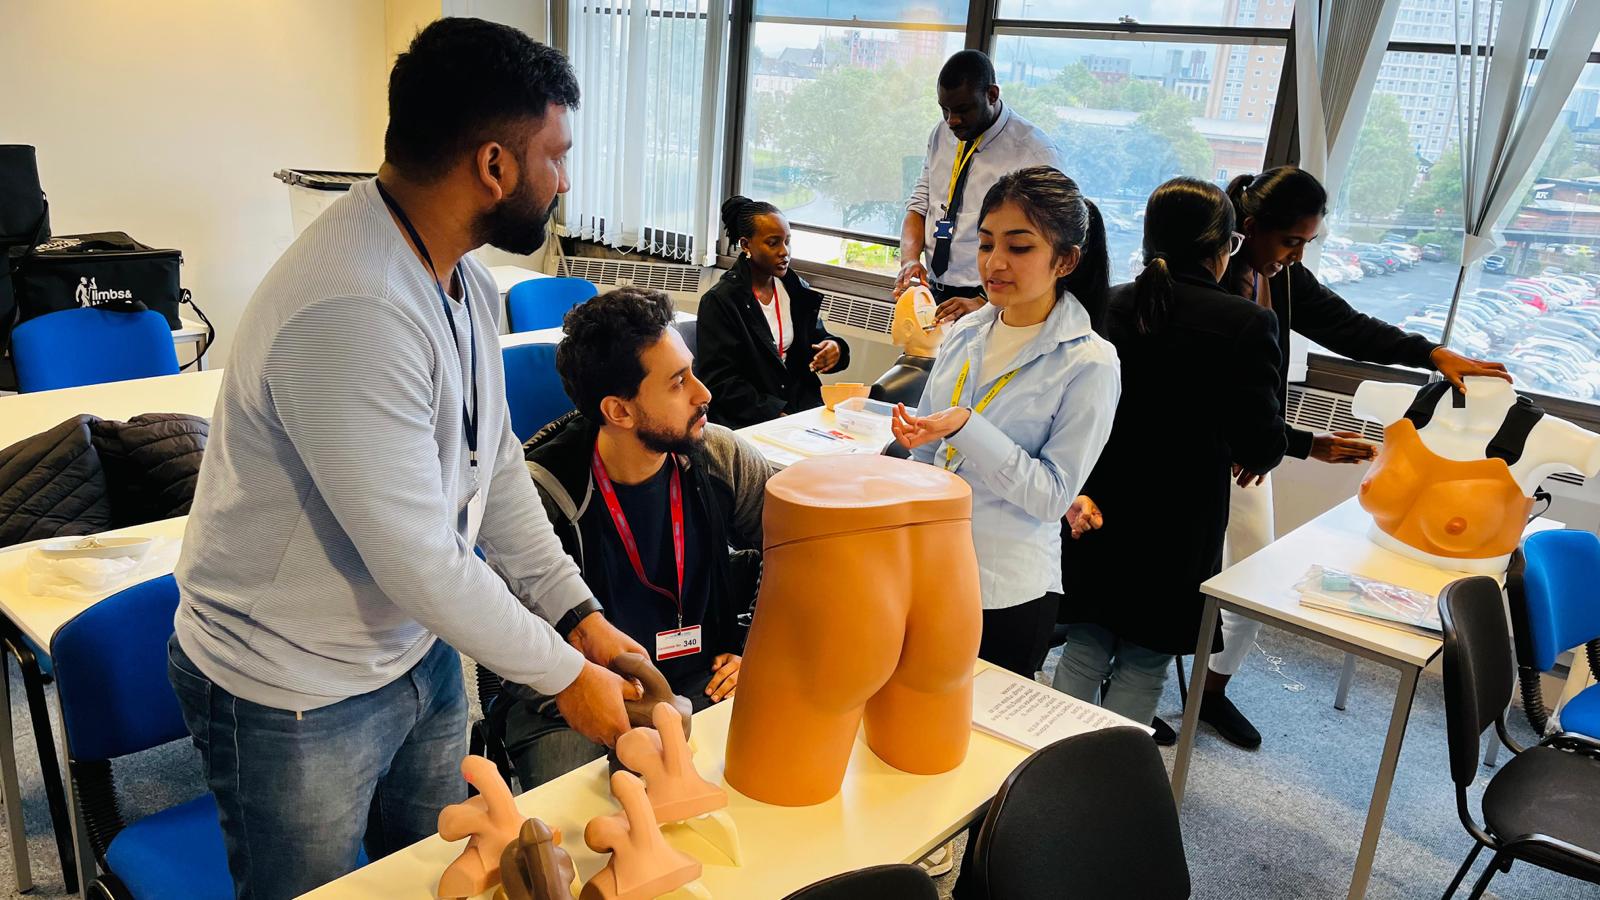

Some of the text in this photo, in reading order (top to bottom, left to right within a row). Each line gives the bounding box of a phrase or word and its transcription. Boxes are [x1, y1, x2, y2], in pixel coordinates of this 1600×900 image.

[1535, 191, 1549, 199] KFC
[91, 289, 132, 300] limbs&
[683, 639, 697, 647] 340
